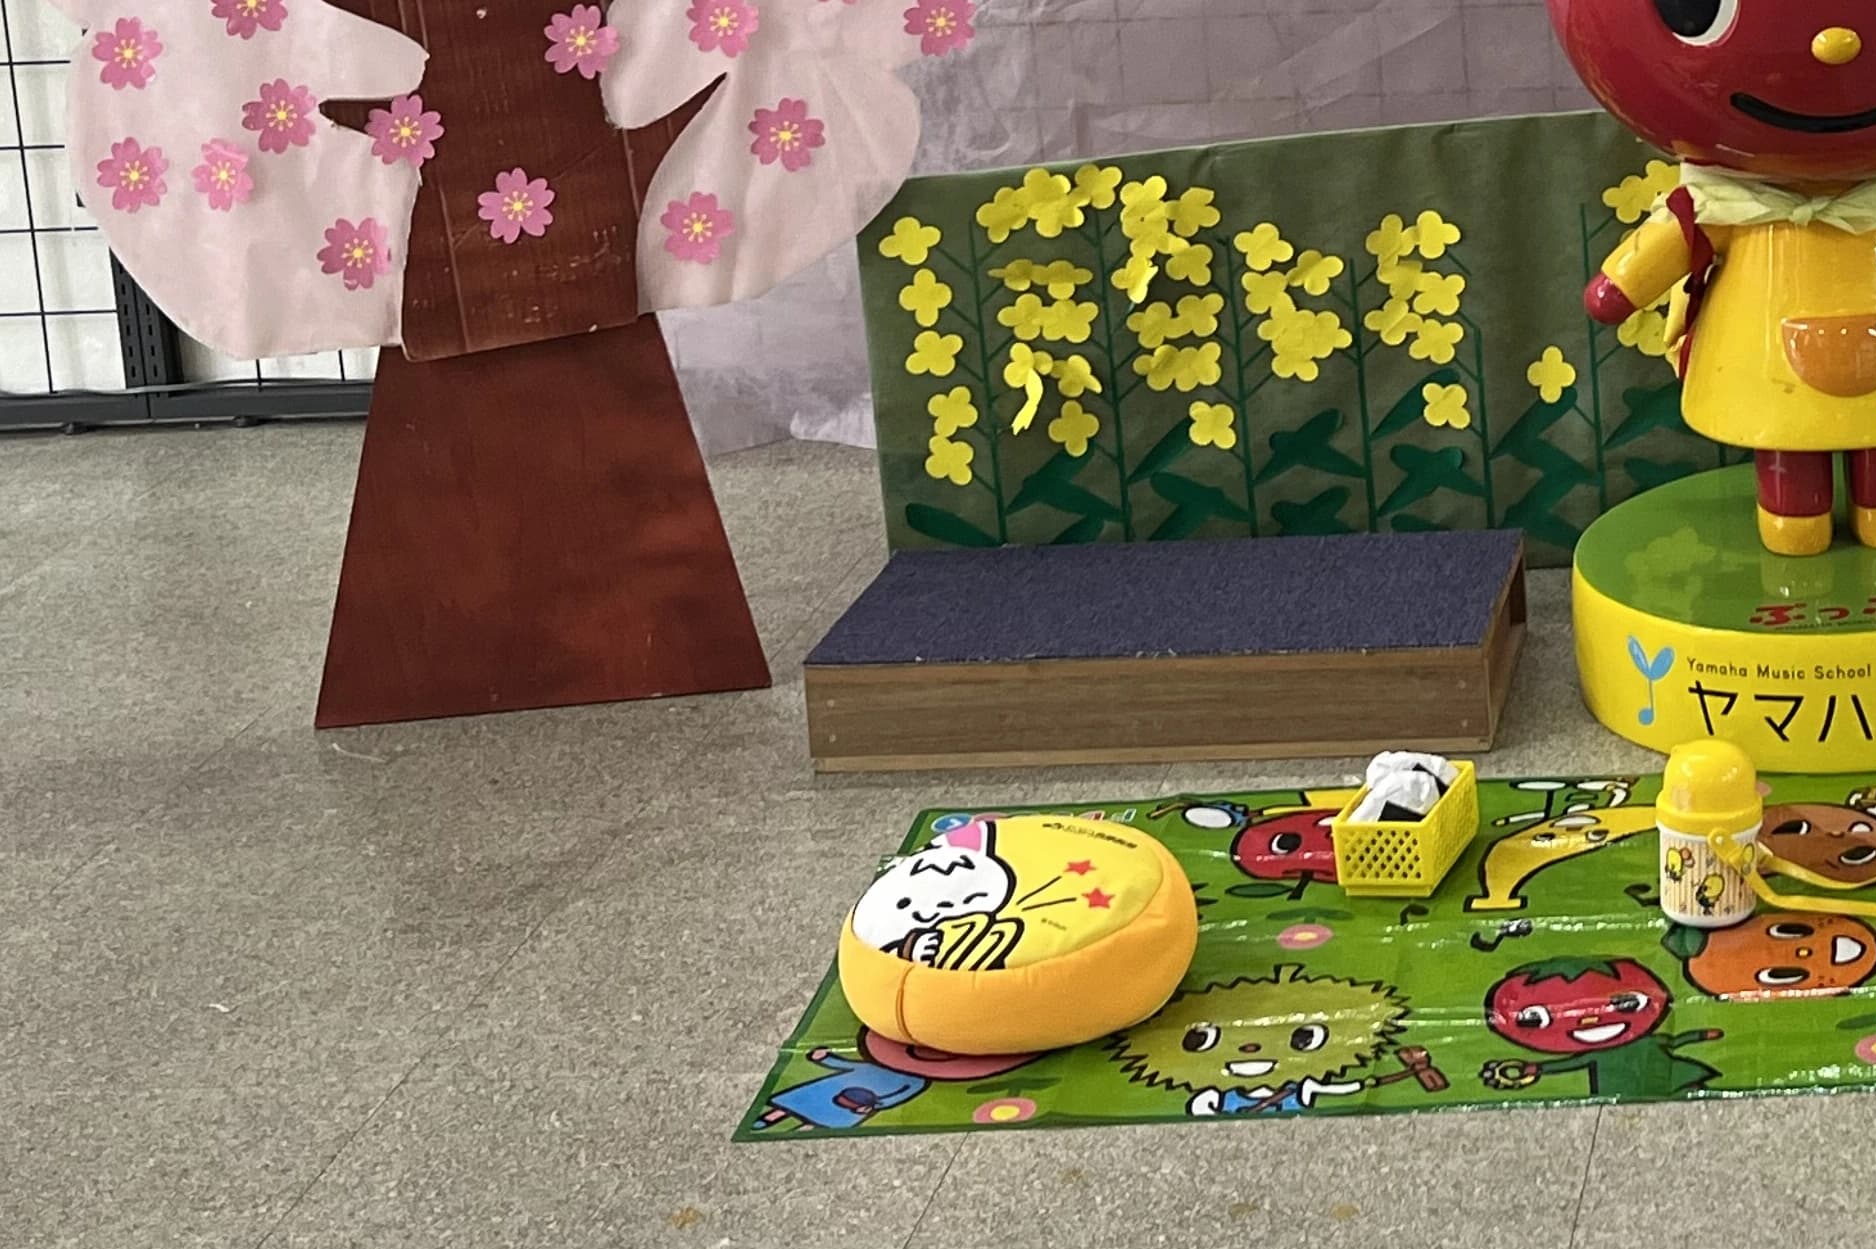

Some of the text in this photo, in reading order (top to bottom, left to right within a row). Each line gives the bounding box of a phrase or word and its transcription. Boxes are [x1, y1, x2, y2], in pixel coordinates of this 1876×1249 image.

[1687, 655, 1873, 681] Yamaha Music School
